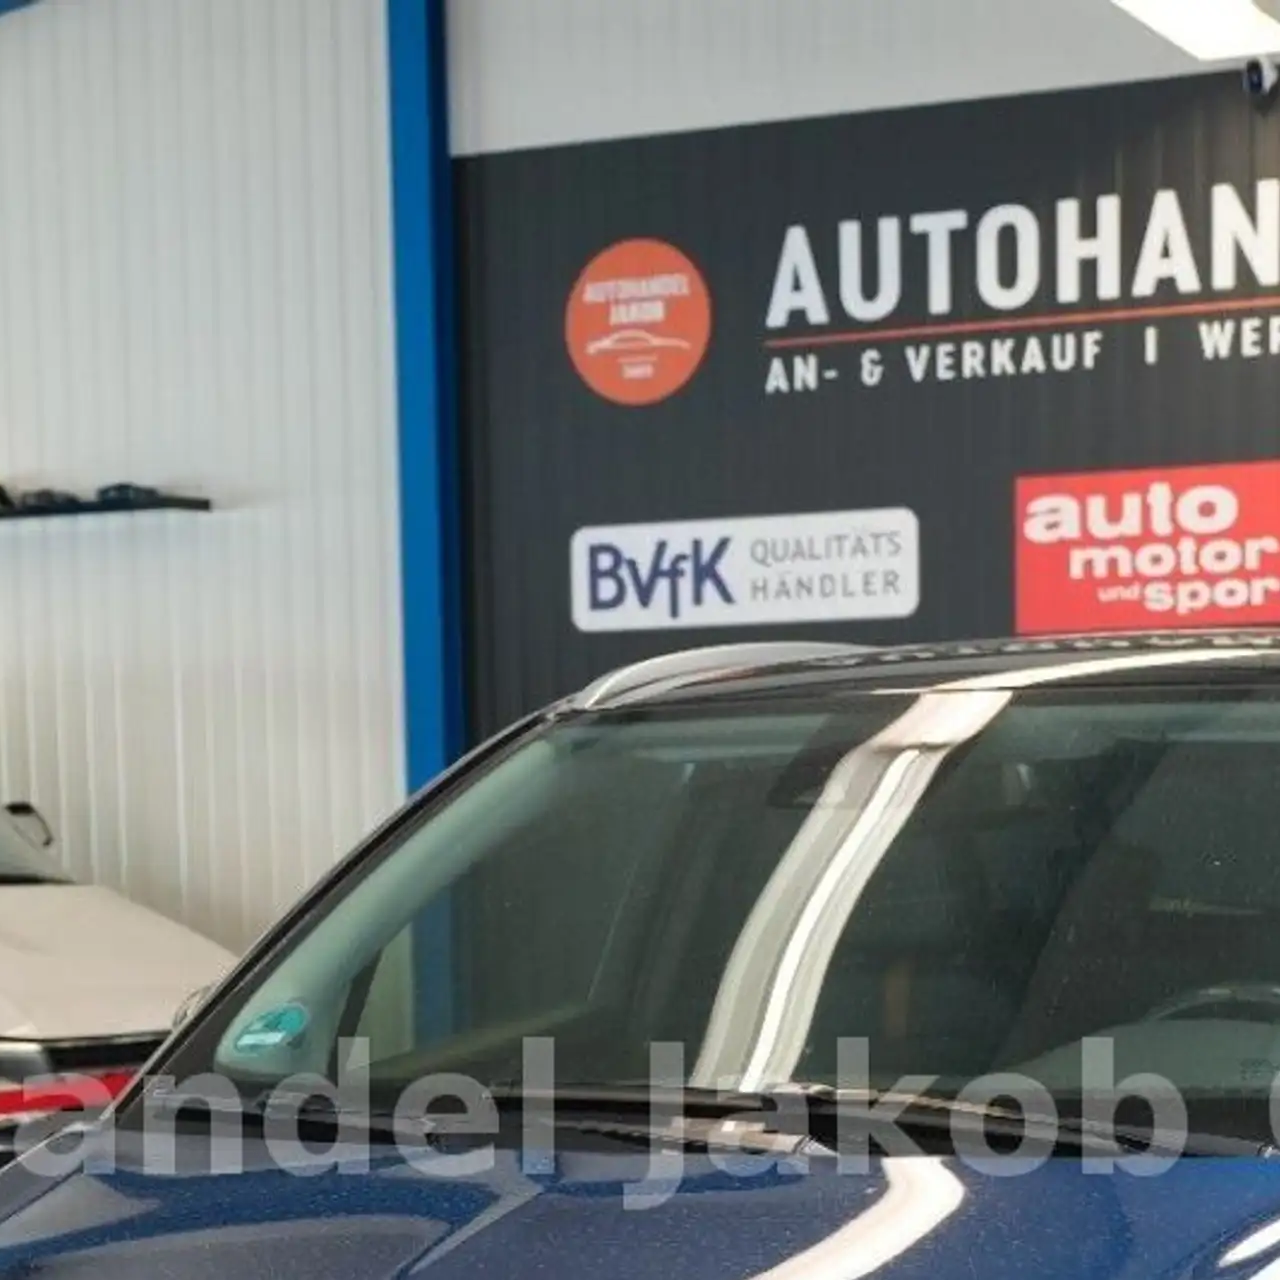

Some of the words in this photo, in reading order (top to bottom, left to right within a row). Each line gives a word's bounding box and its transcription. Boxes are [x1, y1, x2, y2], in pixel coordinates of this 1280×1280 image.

[765, 353, 839, 394] AN-
[860, 349, 884, 387] &
[904, 330, 1103, 383] VERKAUF
[1022, 480, 1239, 544] auto
